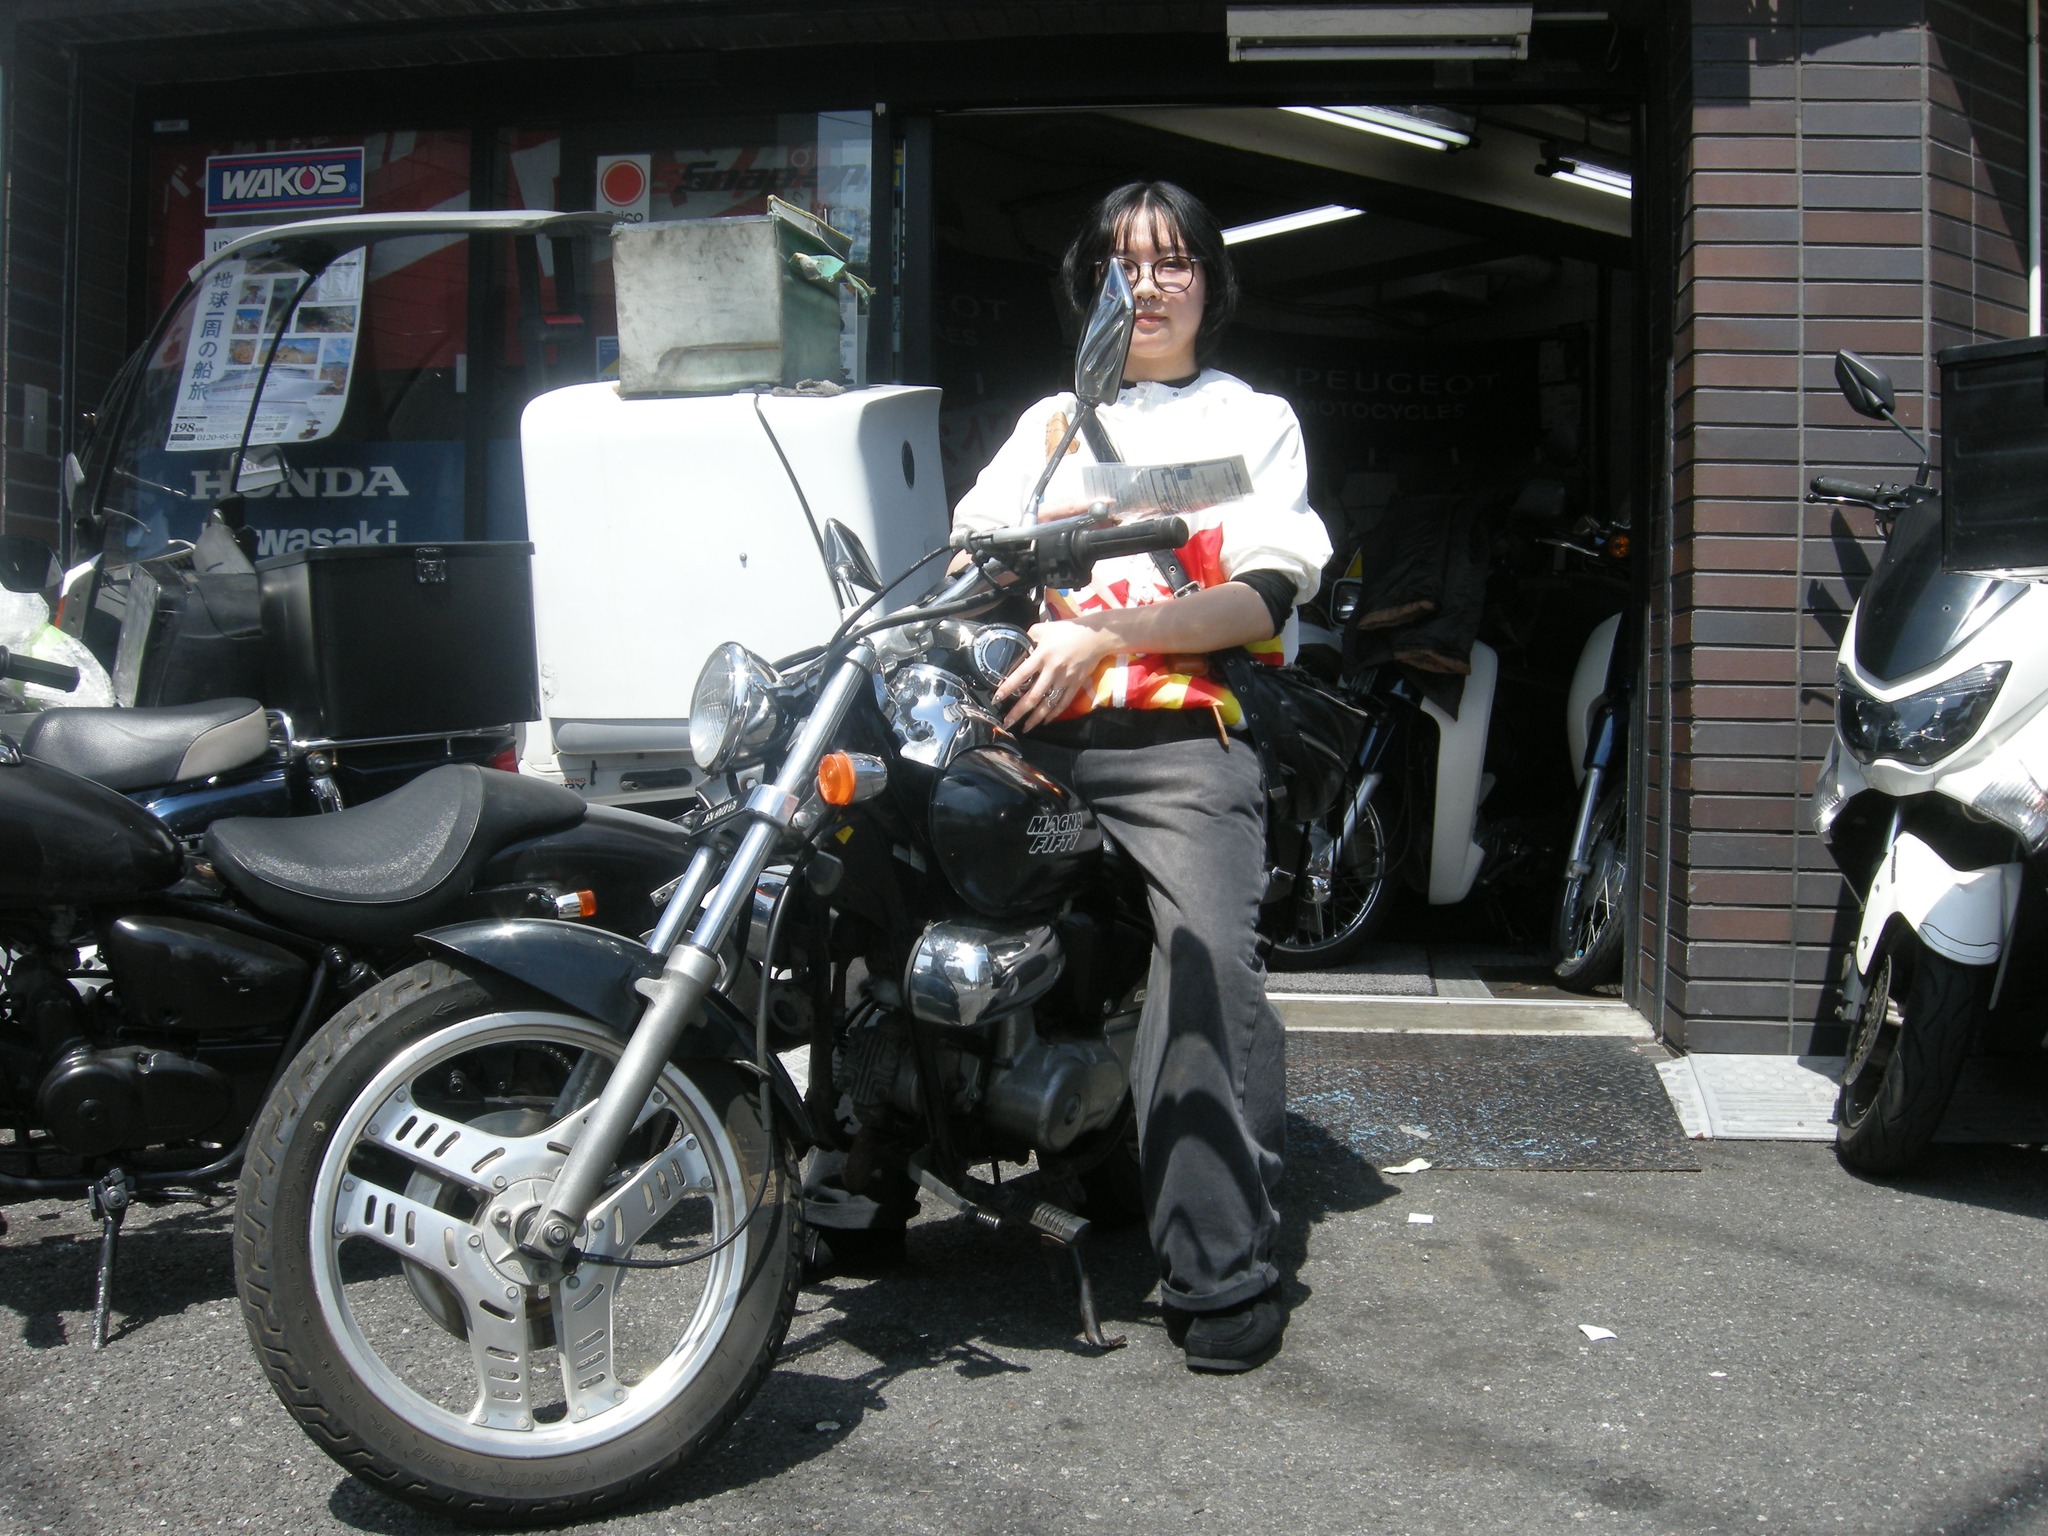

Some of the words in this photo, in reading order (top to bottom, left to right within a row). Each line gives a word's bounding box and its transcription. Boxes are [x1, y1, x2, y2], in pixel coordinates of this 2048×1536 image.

[222, 164, 347, 200] WAKO'S
[187, 271, 234, 401] 地球一周の船旅
[1295, 366, 1504, 395] PEUGEOT
[191, 466, 409, 500] HNDA
[252, 520, 398, 556] wasaki
[1027, 812, 1083, 835] MAGNA
[1029, 832, 1081, 854] FIFTY
